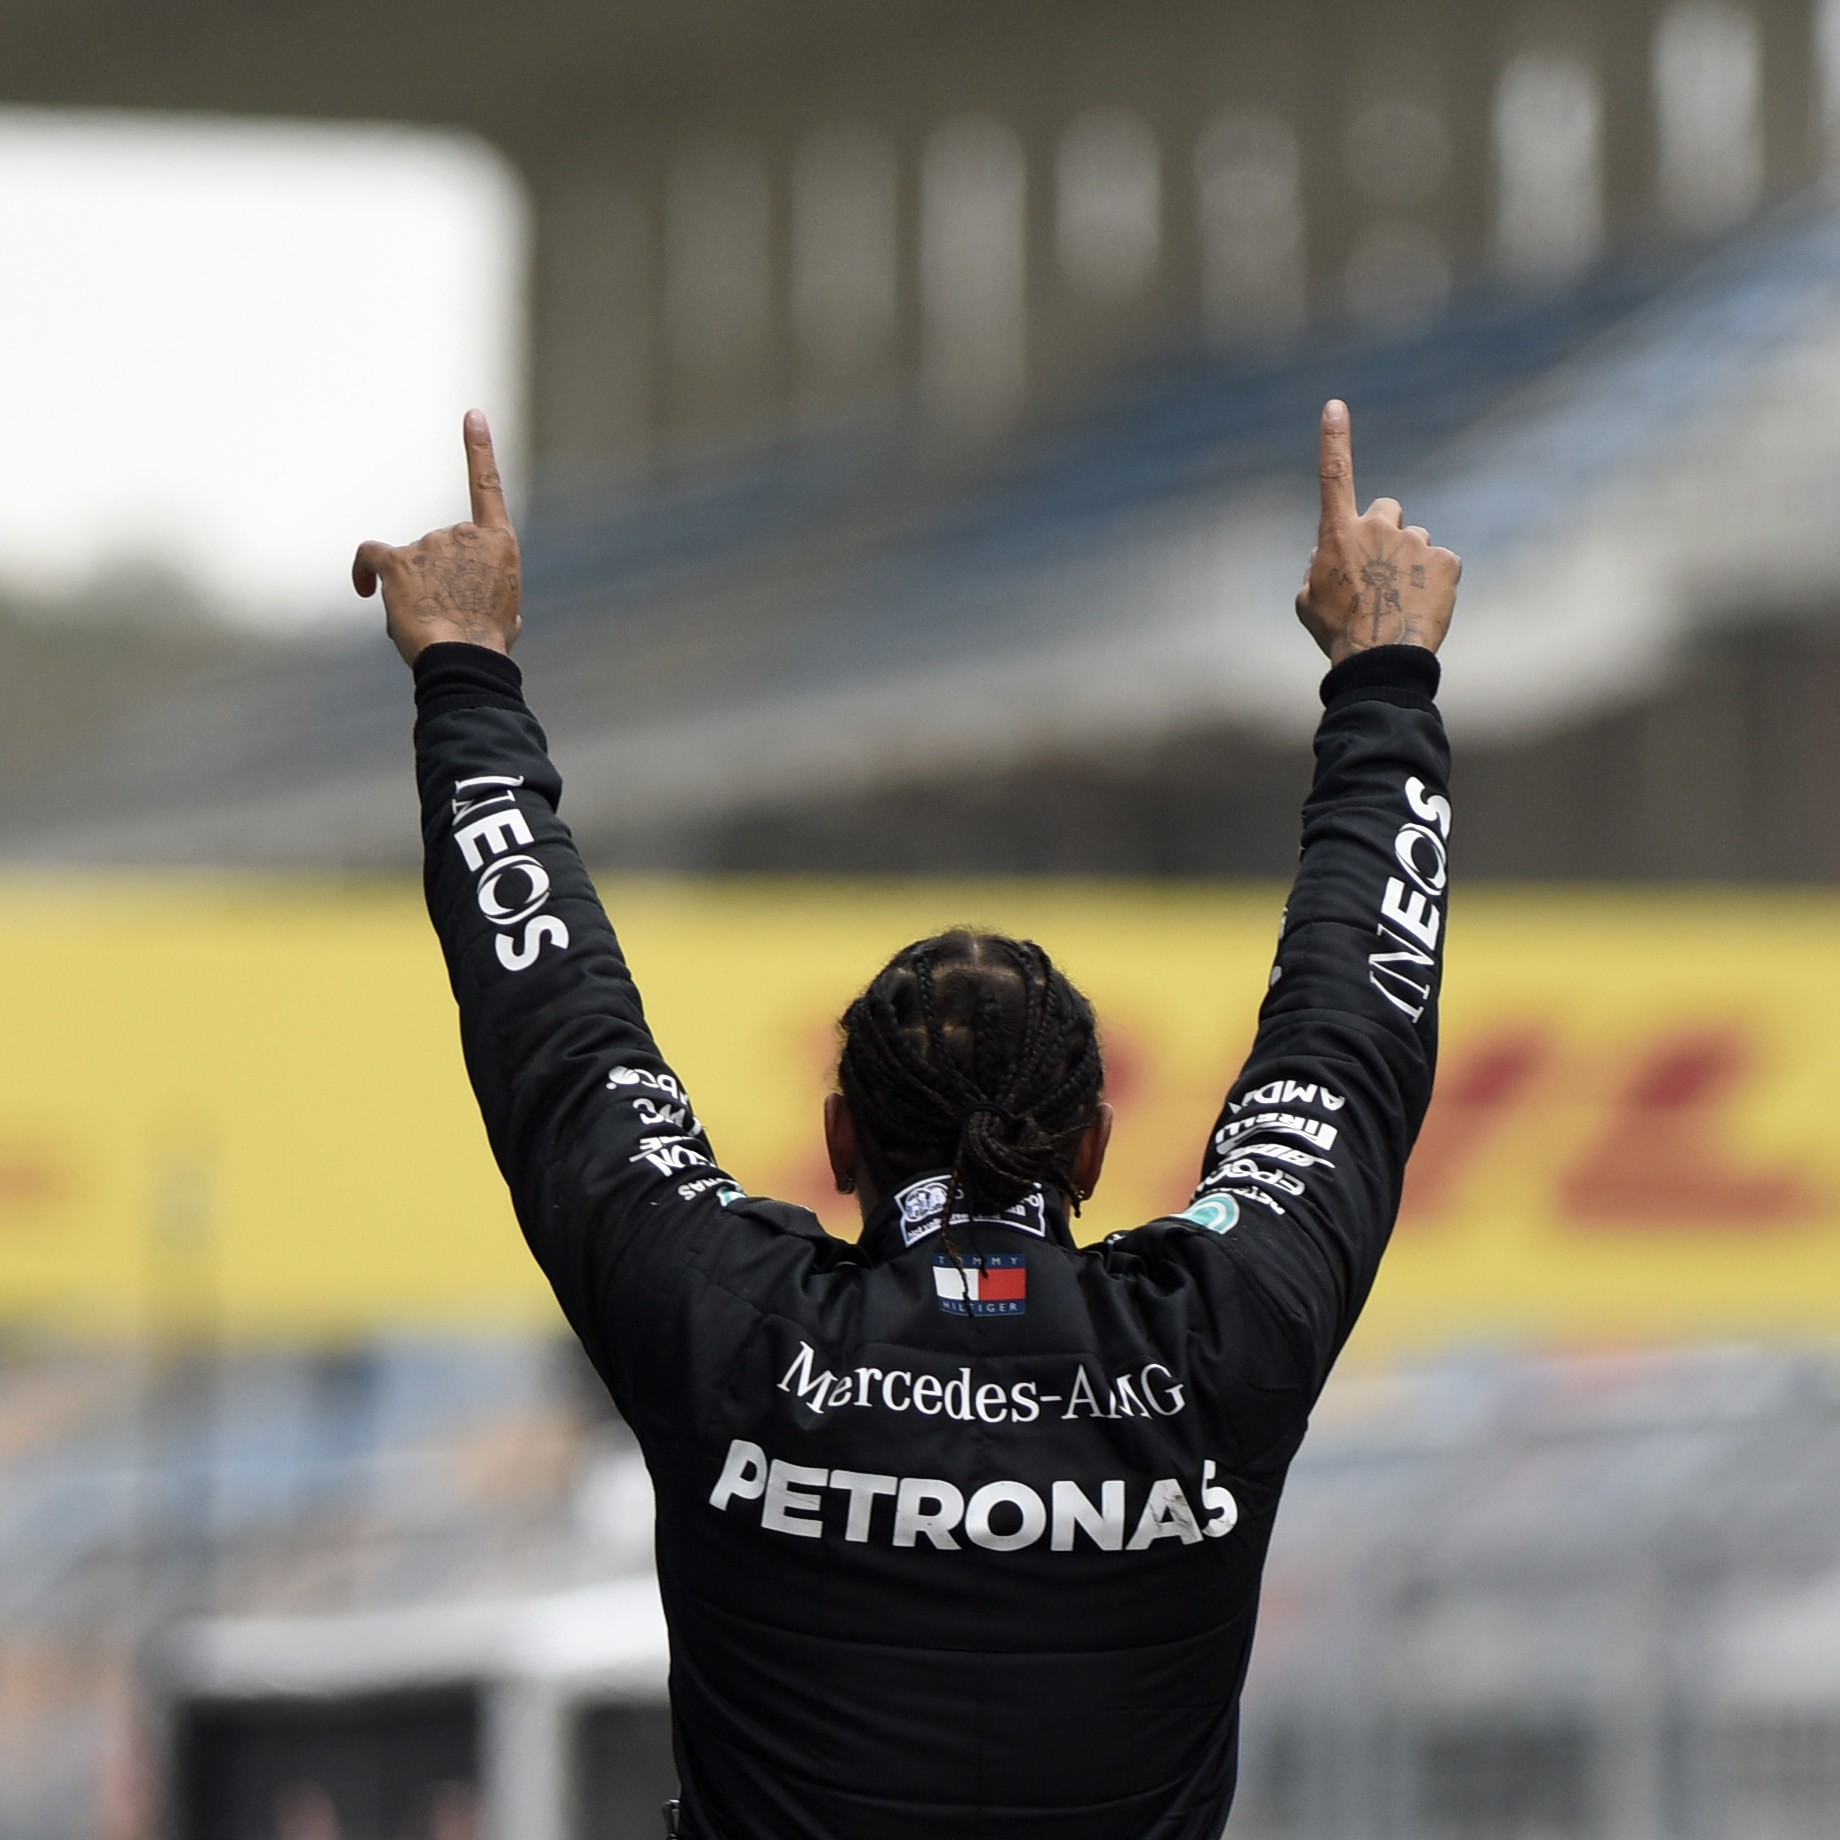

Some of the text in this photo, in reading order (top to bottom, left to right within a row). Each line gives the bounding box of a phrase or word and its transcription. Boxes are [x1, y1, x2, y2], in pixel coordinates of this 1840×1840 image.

[451, 775, 569, 972] INEOS
[1368, 776, 1452, 1024] INEOS
[1215, 1113, 1338, 1155] PIRELLI
[1254, 1080, 1346, 1111] AMD
[776, 1340, 1186, 1423] Mercedes-AMG
[708, 1438, 1238, 1552] PETRONAS
